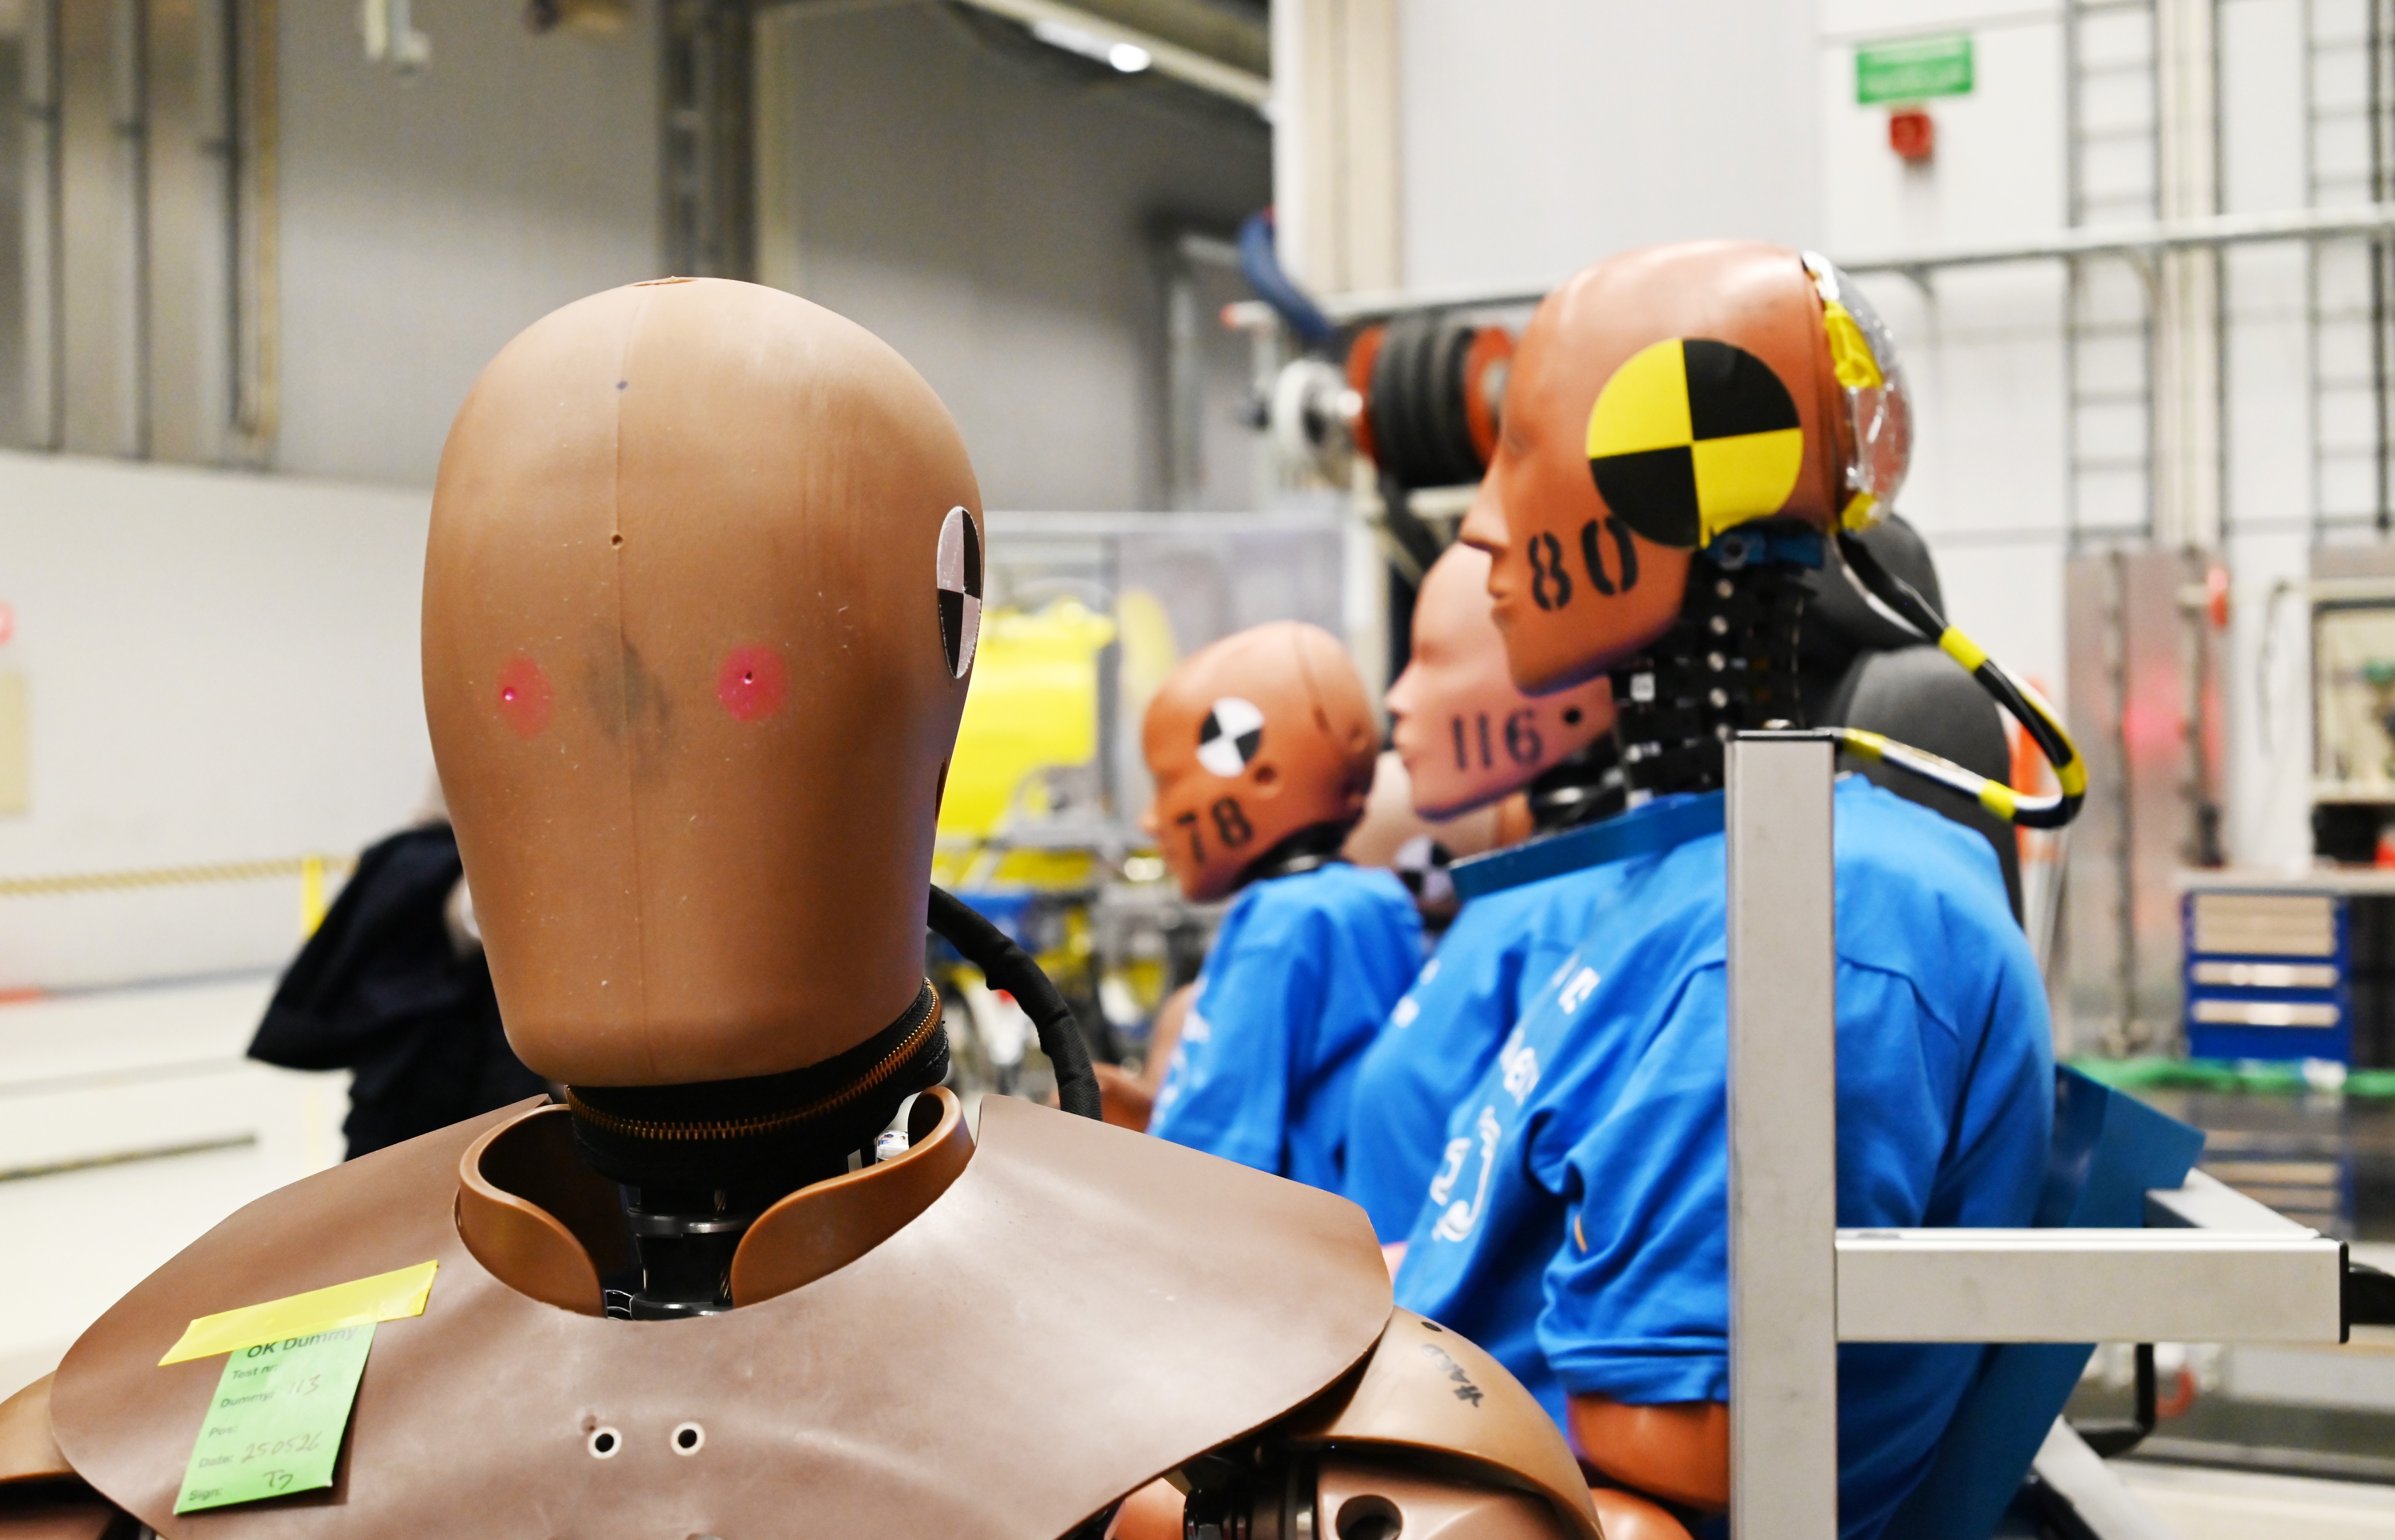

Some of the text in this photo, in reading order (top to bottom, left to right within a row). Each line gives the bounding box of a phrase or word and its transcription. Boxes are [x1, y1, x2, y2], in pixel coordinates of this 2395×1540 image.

[1528, 515, 1639, 612] 80
[1453, 709, 1543, 768] 116
[1175, 797, 1253, 865] 78
[247, 1327, 357, 1358] OK Dummy
[233, 1368, 258, 1380] Test
[220, 1391, 274, 1408] Dummy:
[199, 1454, 234, 1468] Date:
